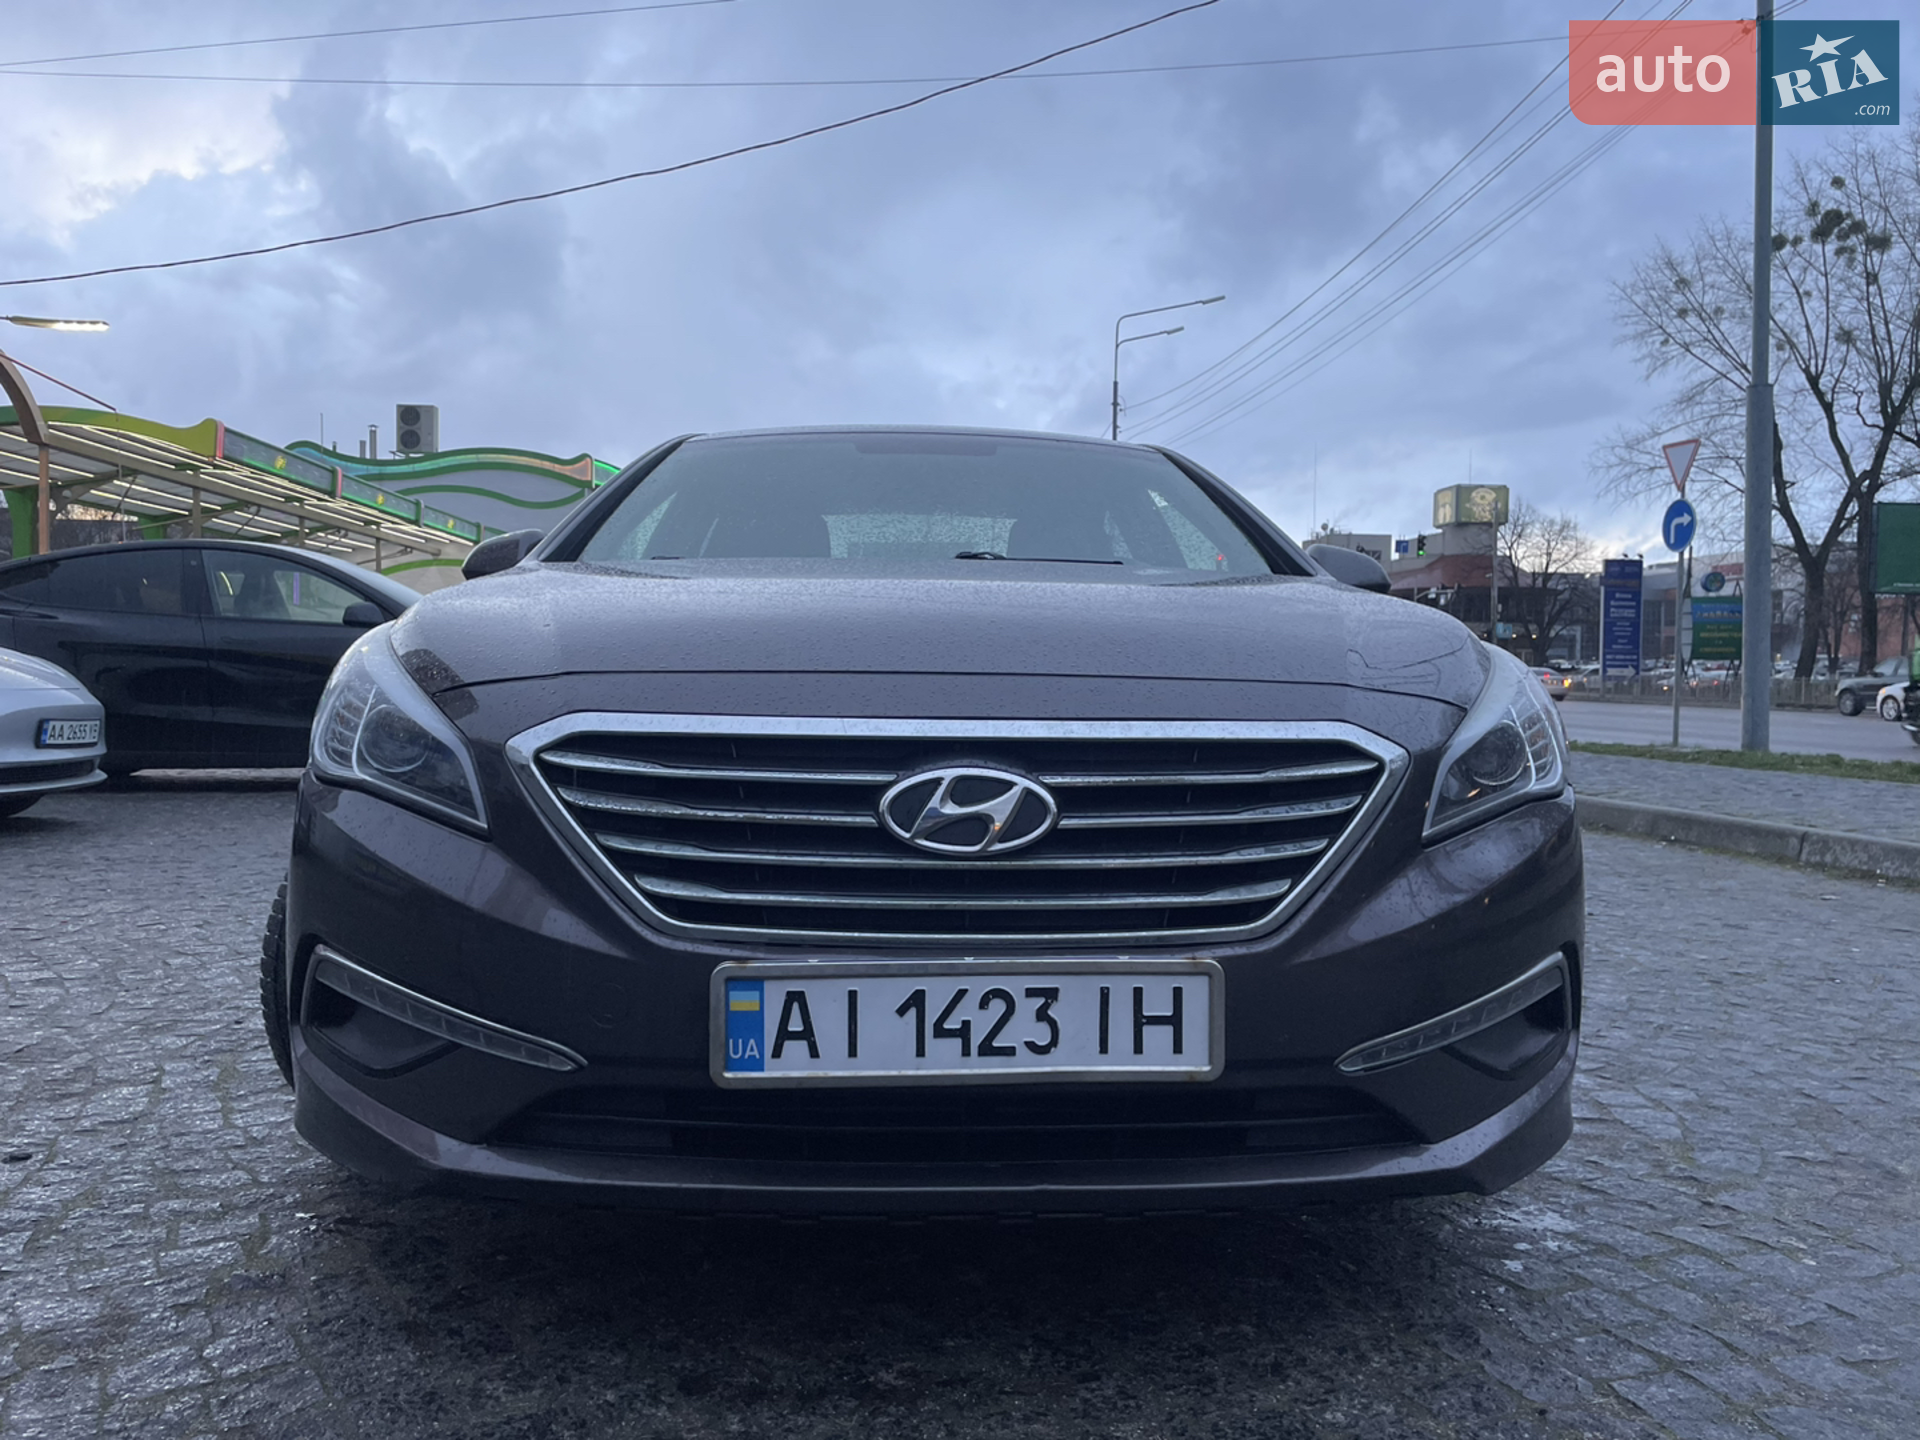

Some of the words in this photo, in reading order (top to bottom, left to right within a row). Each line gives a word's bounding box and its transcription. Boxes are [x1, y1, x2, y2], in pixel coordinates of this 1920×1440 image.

[48, 724, 64, 740] AA
[770, 989, 858, 1059] AI
[894, 986, 1060, 1058] 1423
[1098, 985, 1183, 1055] IH
[728, 1037, 760, 1059] UA
